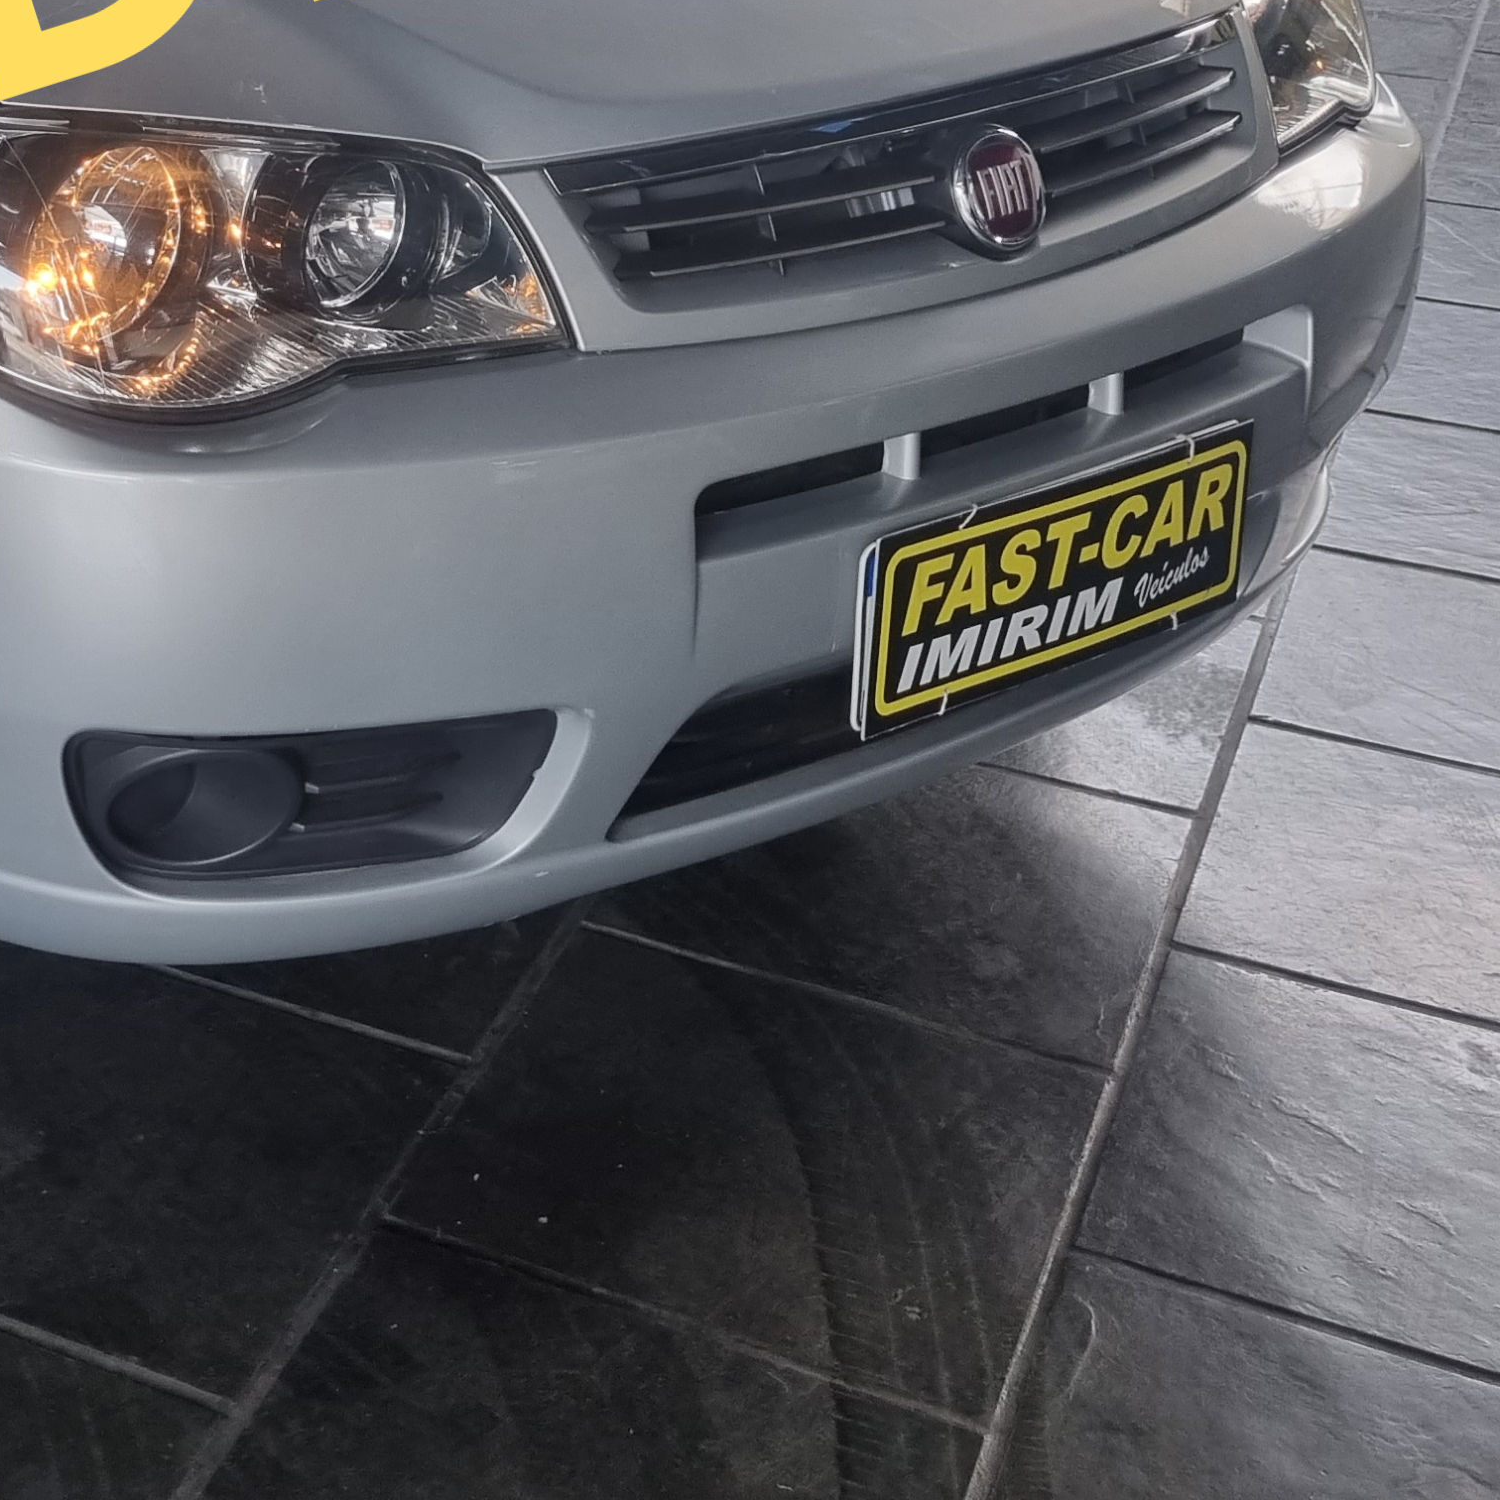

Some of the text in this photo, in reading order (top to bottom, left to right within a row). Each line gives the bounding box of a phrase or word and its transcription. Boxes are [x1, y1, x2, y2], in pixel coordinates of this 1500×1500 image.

[975, 159, 1029, 221] FIAT
[896, 544, 1211, 695] IMIRIM Veículos
[901, 463, 1234, 638] FAST-CAR
